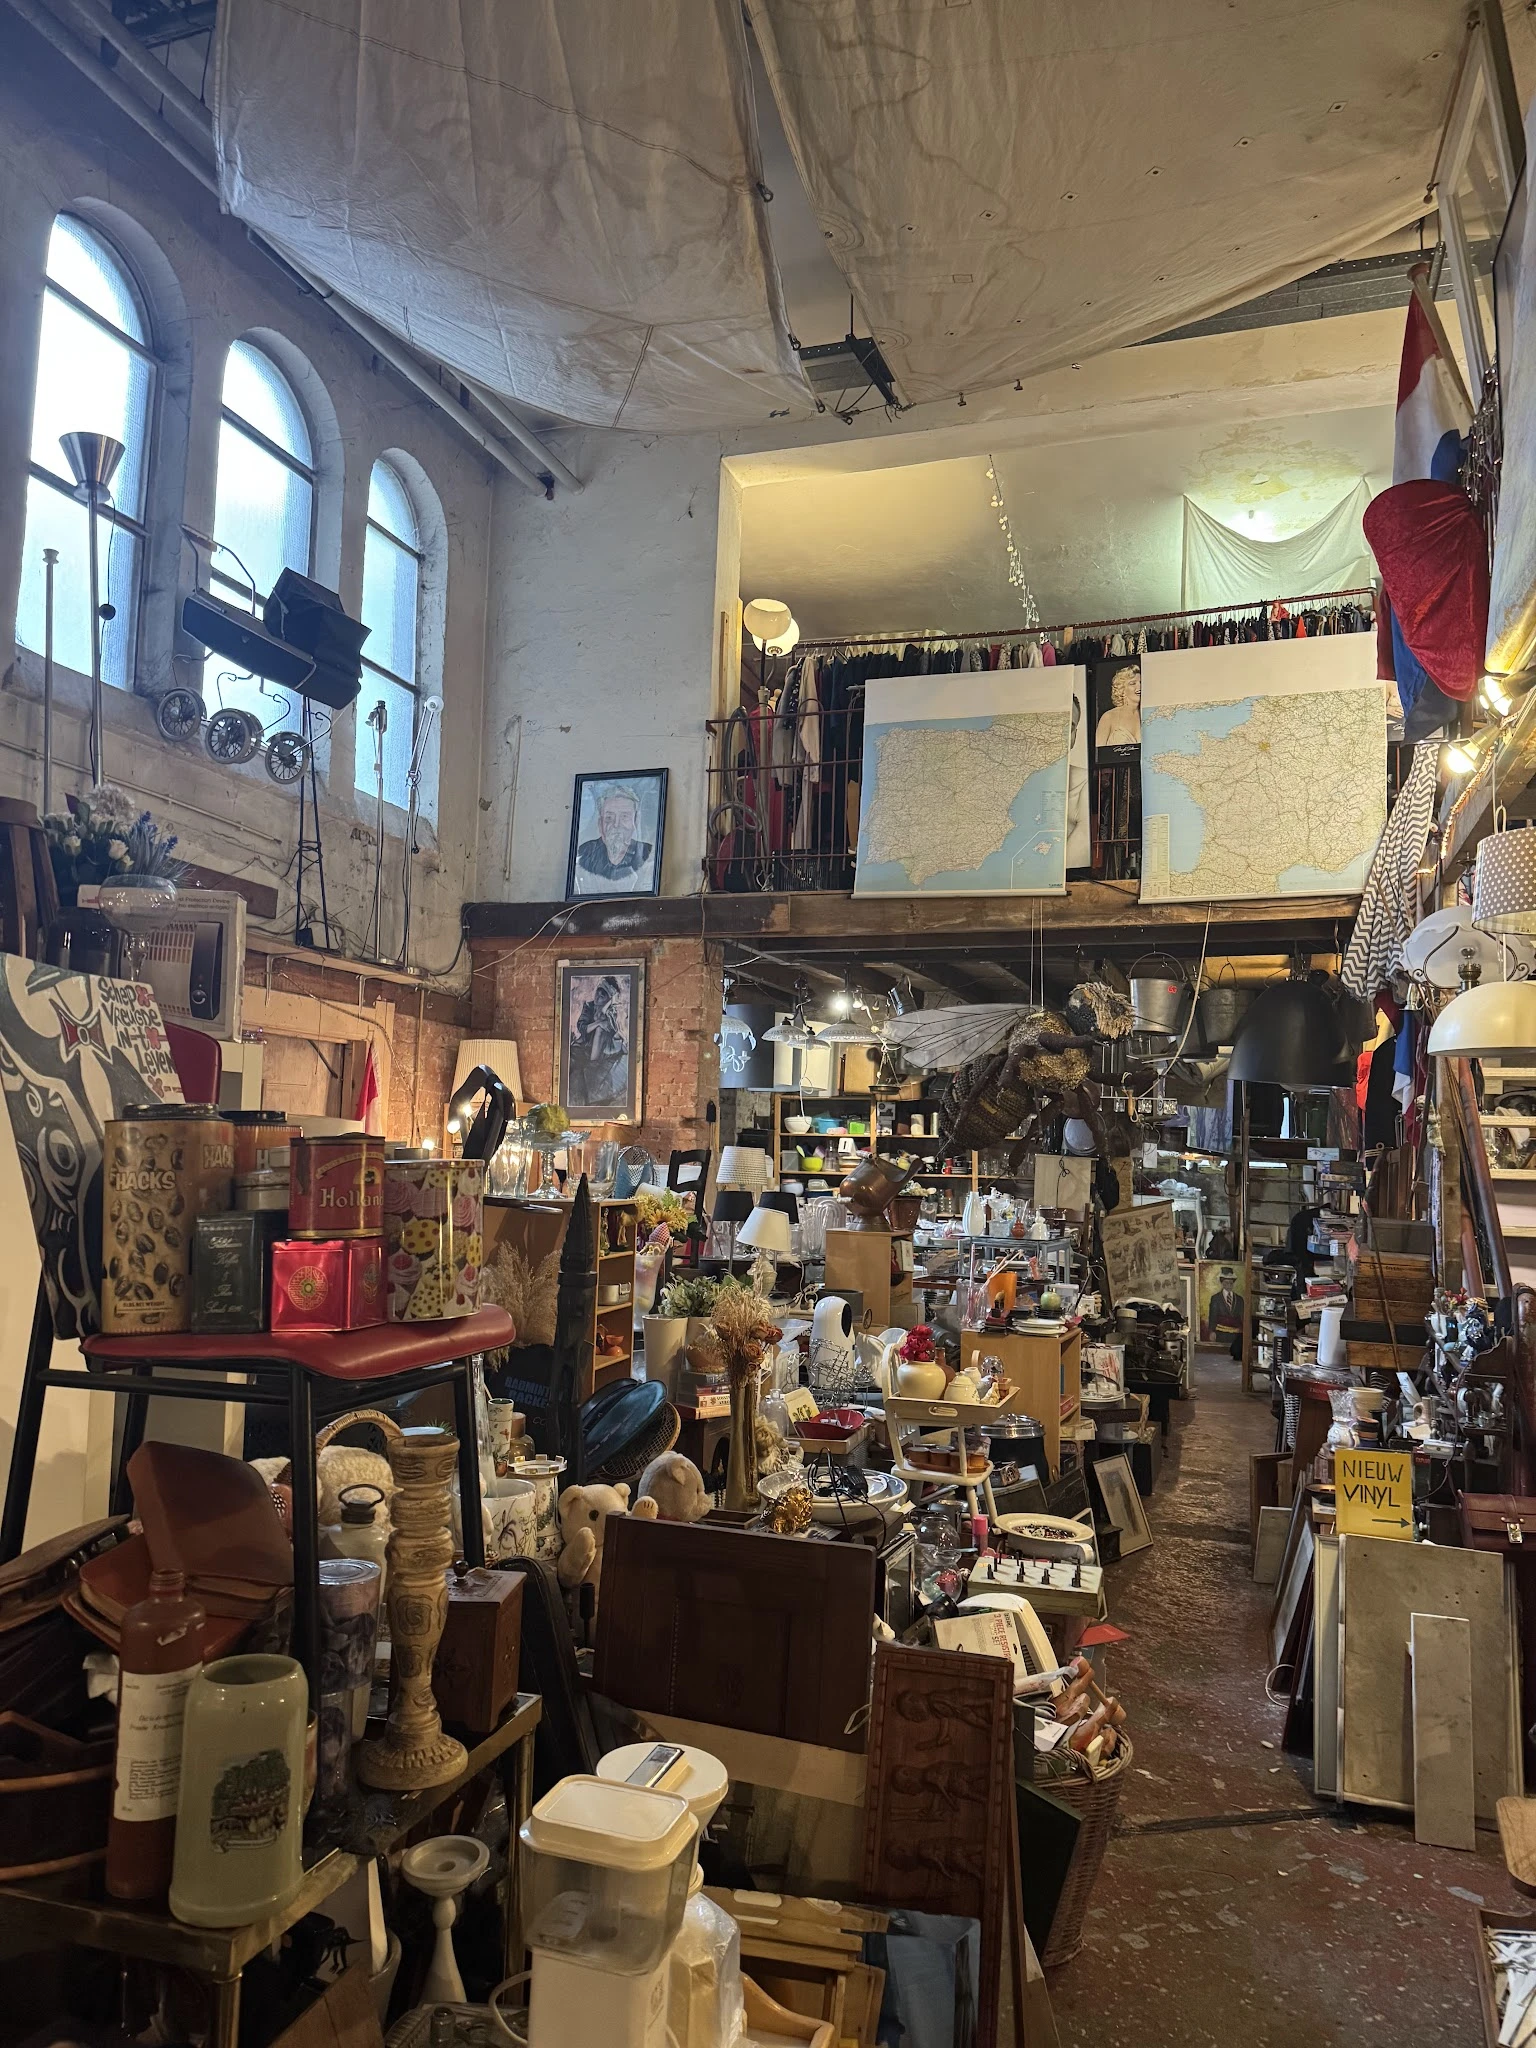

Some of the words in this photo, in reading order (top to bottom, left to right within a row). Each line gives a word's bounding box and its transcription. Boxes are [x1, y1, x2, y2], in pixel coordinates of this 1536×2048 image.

[98, 977, 137, 1010] Schep
[115, 1170, 176, 1191] HACKS
[320, 1186, 384, 1208] Holland
[1343, 1460, 1404, 1483] NIEUW
[1343, 1484, 1401, 1509] VINYL
[995, 1618, 1006, 1634] PIECE
